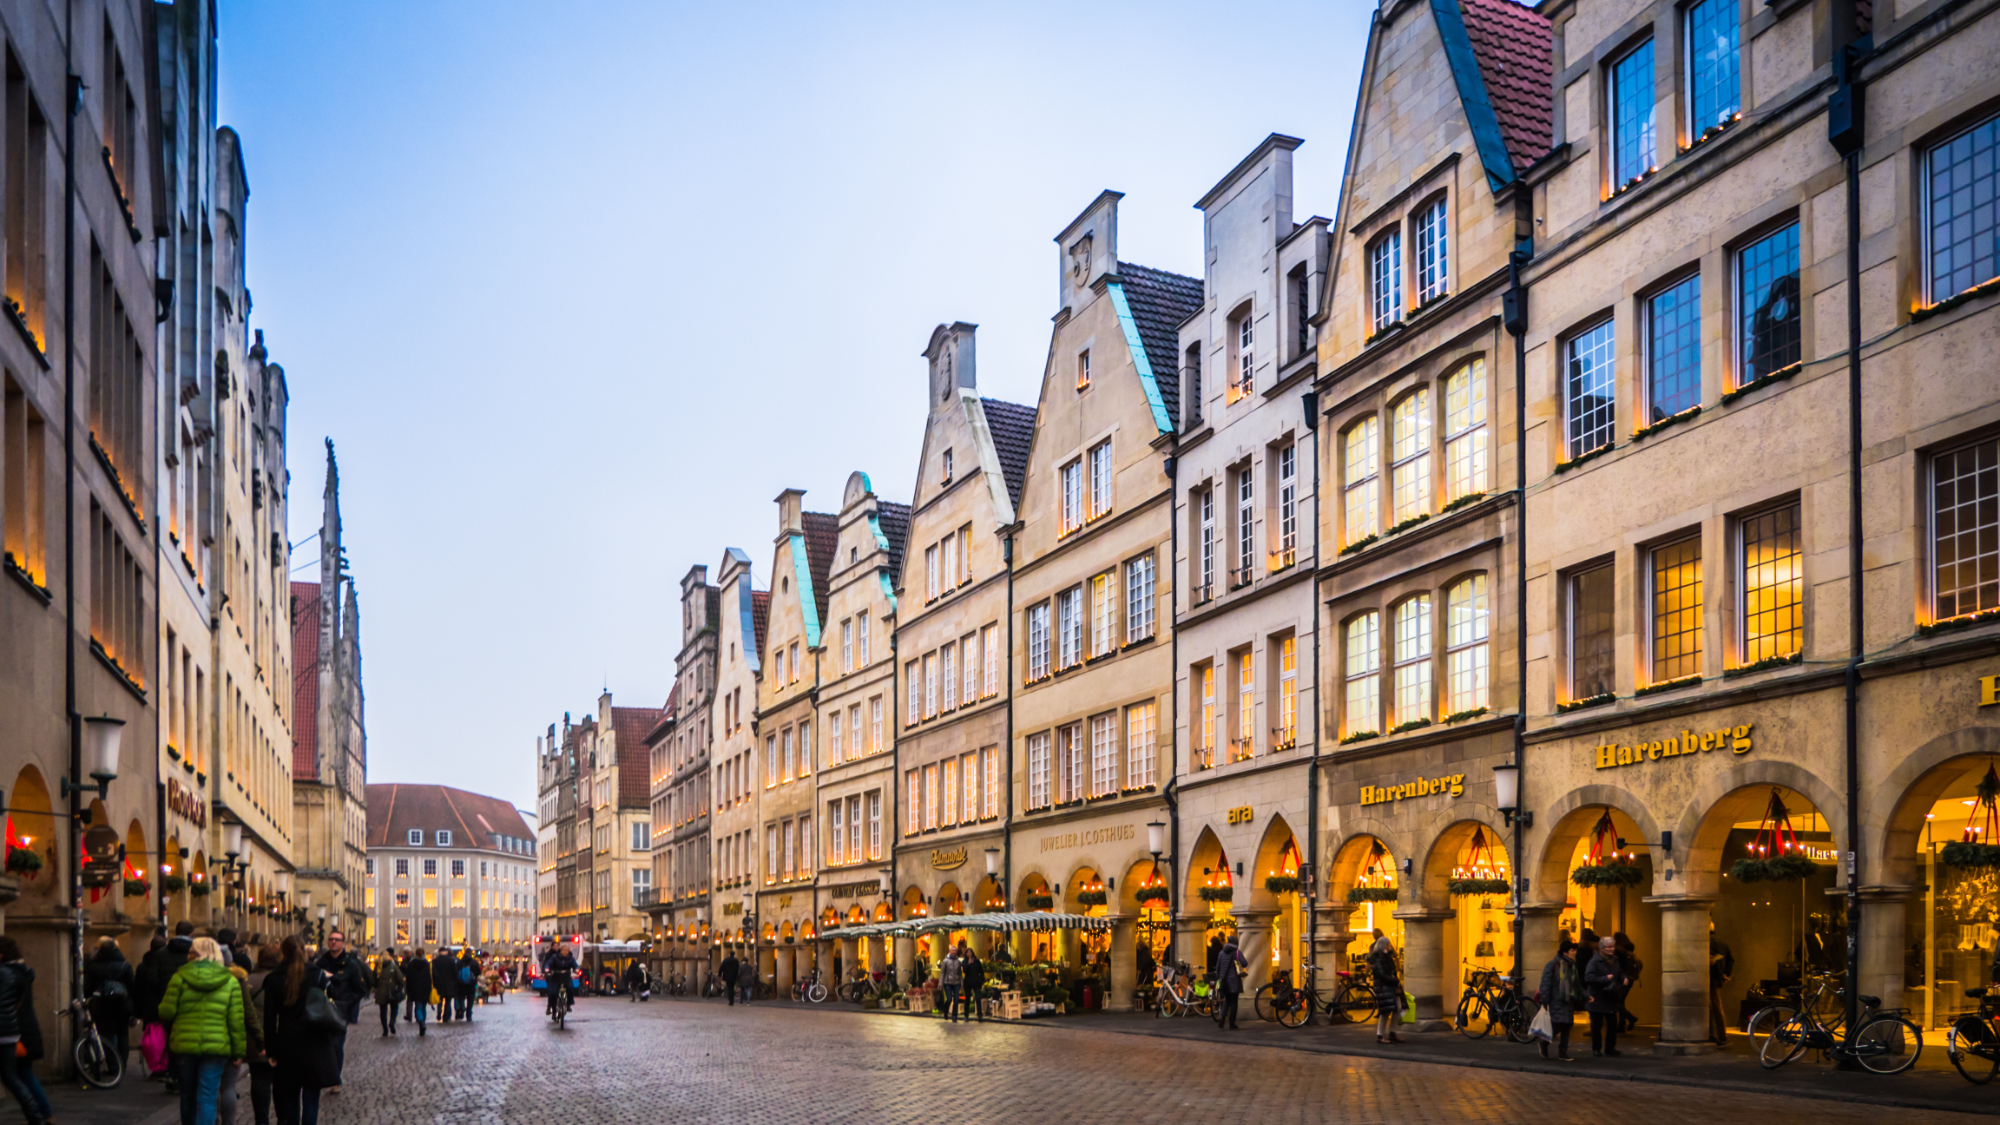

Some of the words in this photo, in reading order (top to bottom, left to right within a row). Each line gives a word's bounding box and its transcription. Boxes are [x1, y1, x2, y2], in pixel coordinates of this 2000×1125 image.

[1595, 723, 1753, 769] Harenberg
[1360, 774, 1465, 806] Harenberg
[1227, 805, 1253, 824] ara
[1040, 833, 1078, 854] JUWELIER
